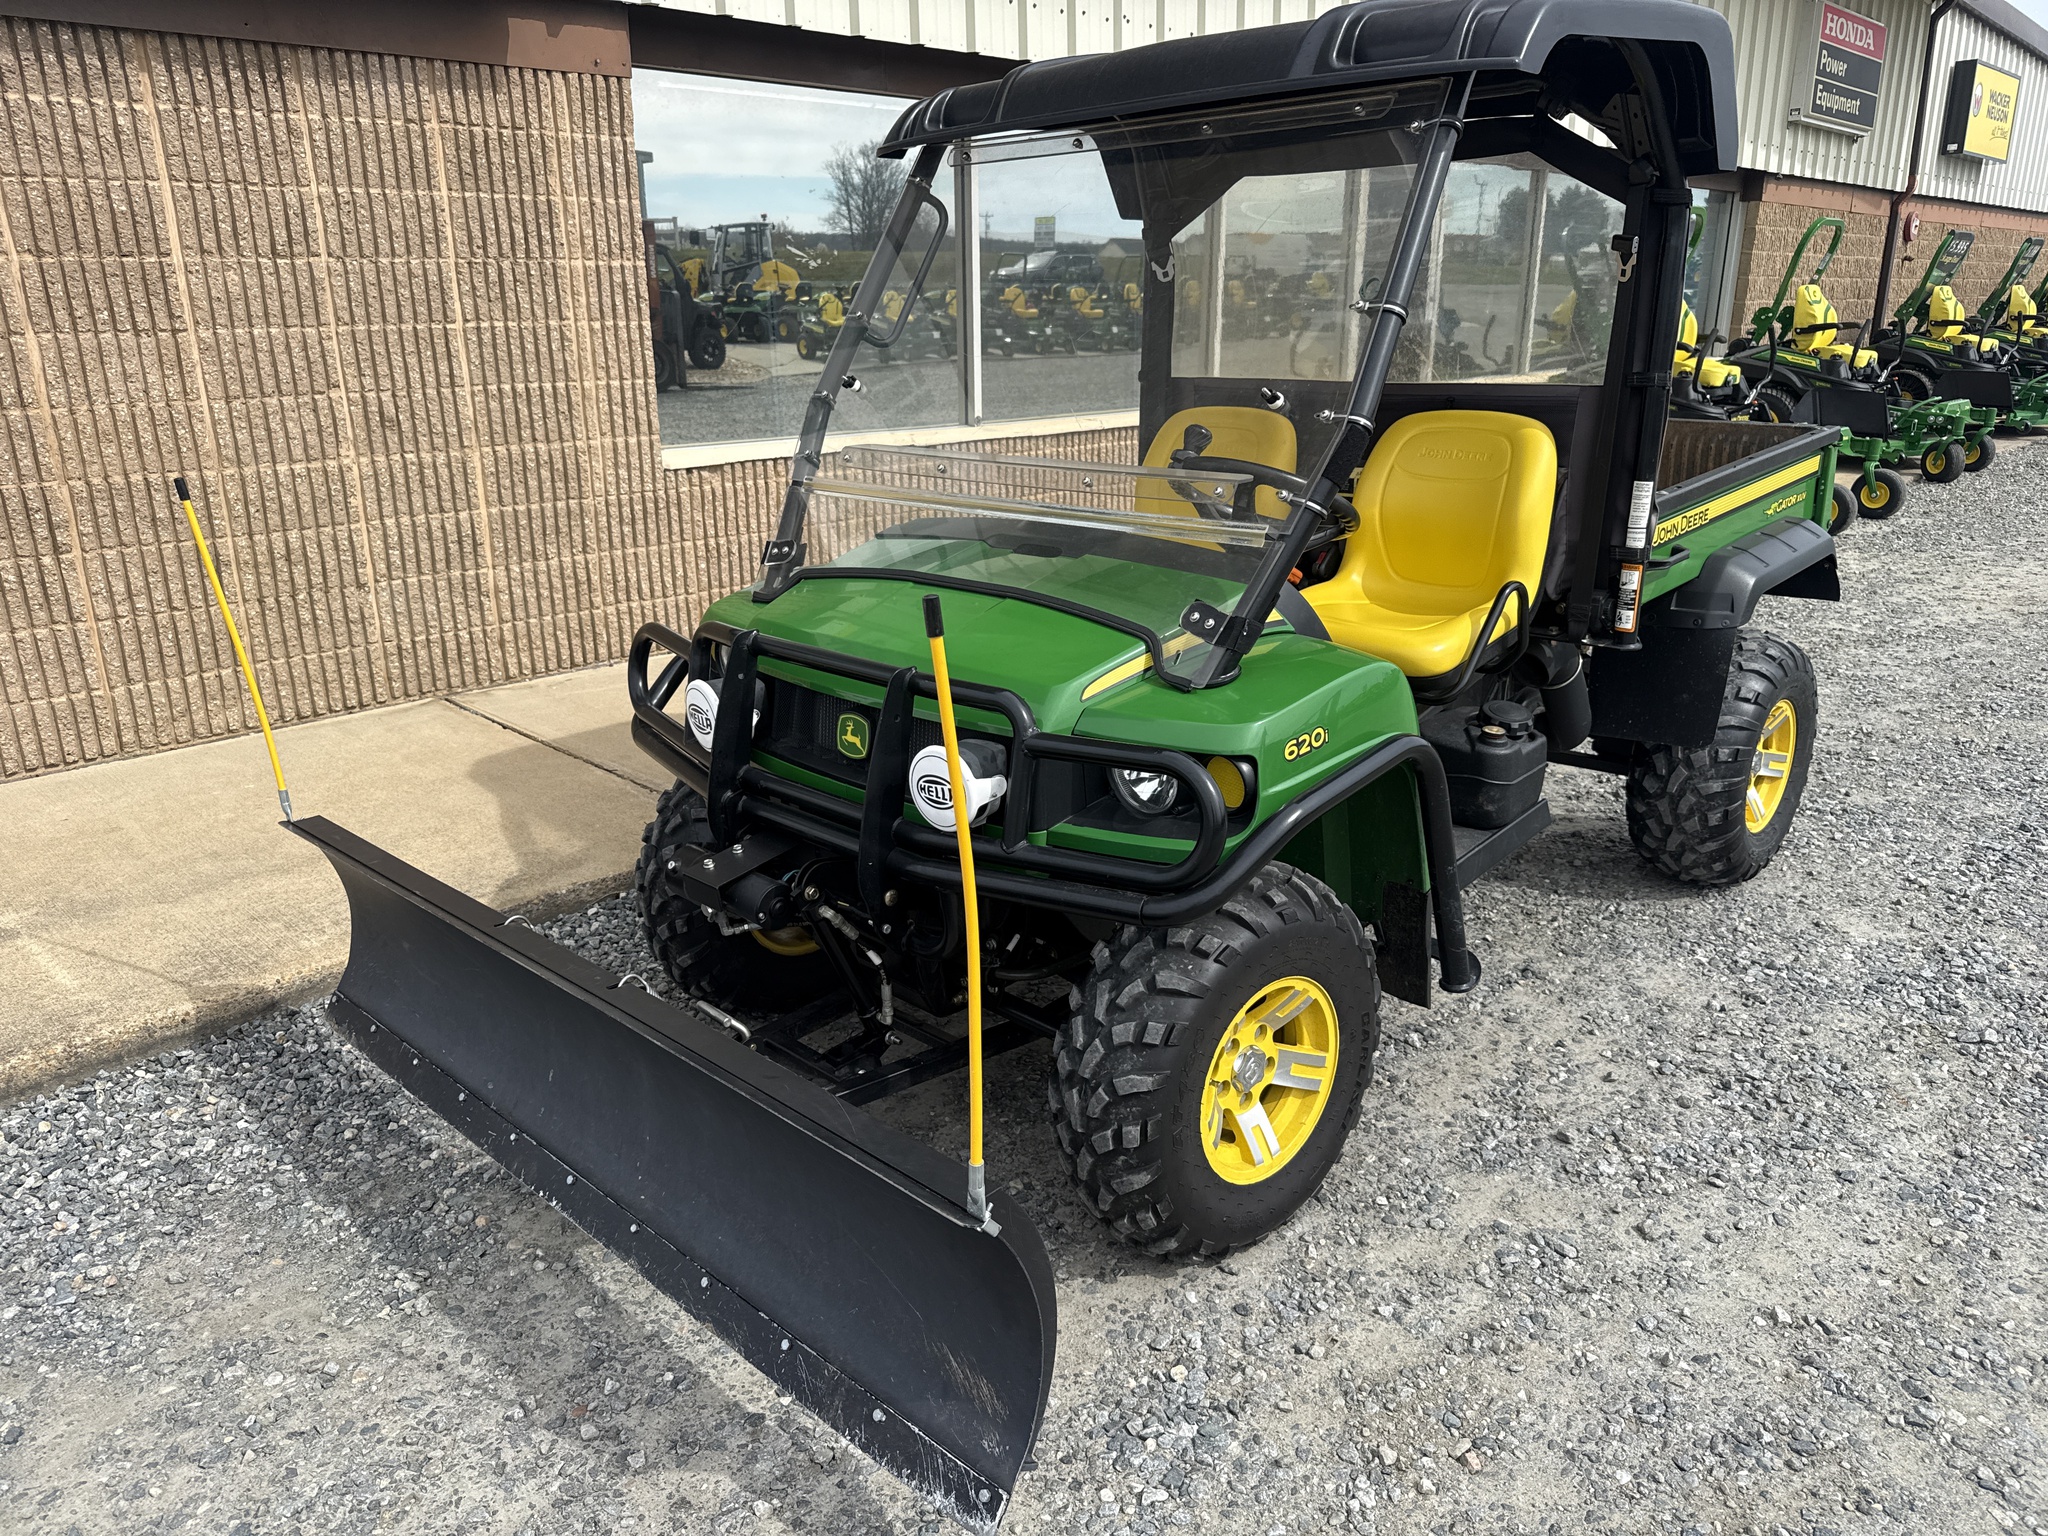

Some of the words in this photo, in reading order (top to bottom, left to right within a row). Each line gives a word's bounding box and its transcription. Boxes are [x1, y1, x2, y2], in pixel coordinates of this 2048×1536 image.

[1825, 12, 1874, 50] HONDA
[1820, 50, 1848, 77] Power
[1815, 84, 1861, 116] Equipment
[1989, 89, 2011, 109] WACKER
[1986, 104, 2010, 124] NEUSON
[1418, 447, 1452, 459] JOHN
[1453, 449, 1493, 461] DEERE
[1776, 493, 1798, 513] GATOR
[1652, 521, 1680, 546] JOHN
[1680, 507, 1710, 533] DEERE
[690, 711, 712, 731] HELLA
[1284, 726, 1329, 762] 620i
